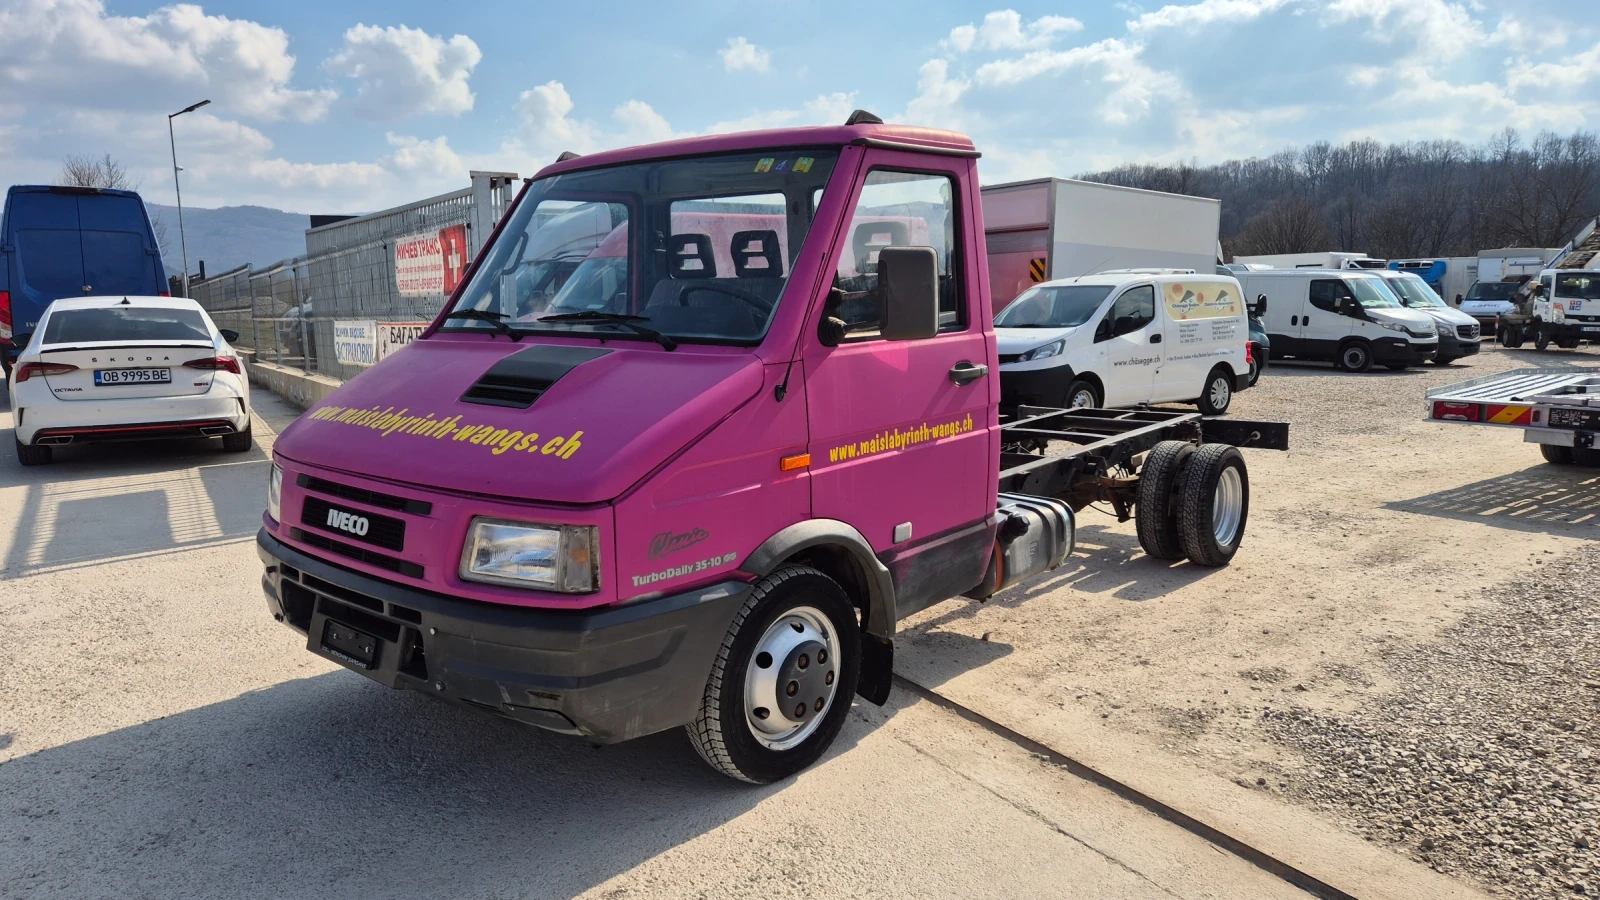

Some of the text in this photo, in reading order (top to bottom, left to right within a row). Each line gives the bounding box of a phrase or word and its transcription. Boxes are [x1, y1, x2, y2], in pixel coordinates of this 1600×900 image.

[418, 237, 441, 257] ТРАНС
[103, 371, 119, 382] OB
[121, 370, 150, 382] 9995
[152, 370, 168, 380] BE
[307, 405, 584, 460] www.maislabyrinth-wangs.ch
[829, 413, 973, 462] www.maislabyrinth-wangs.ch
[326, 508, 369, 536] IVECO
[631, 564, 694, 587] TurboDaily
